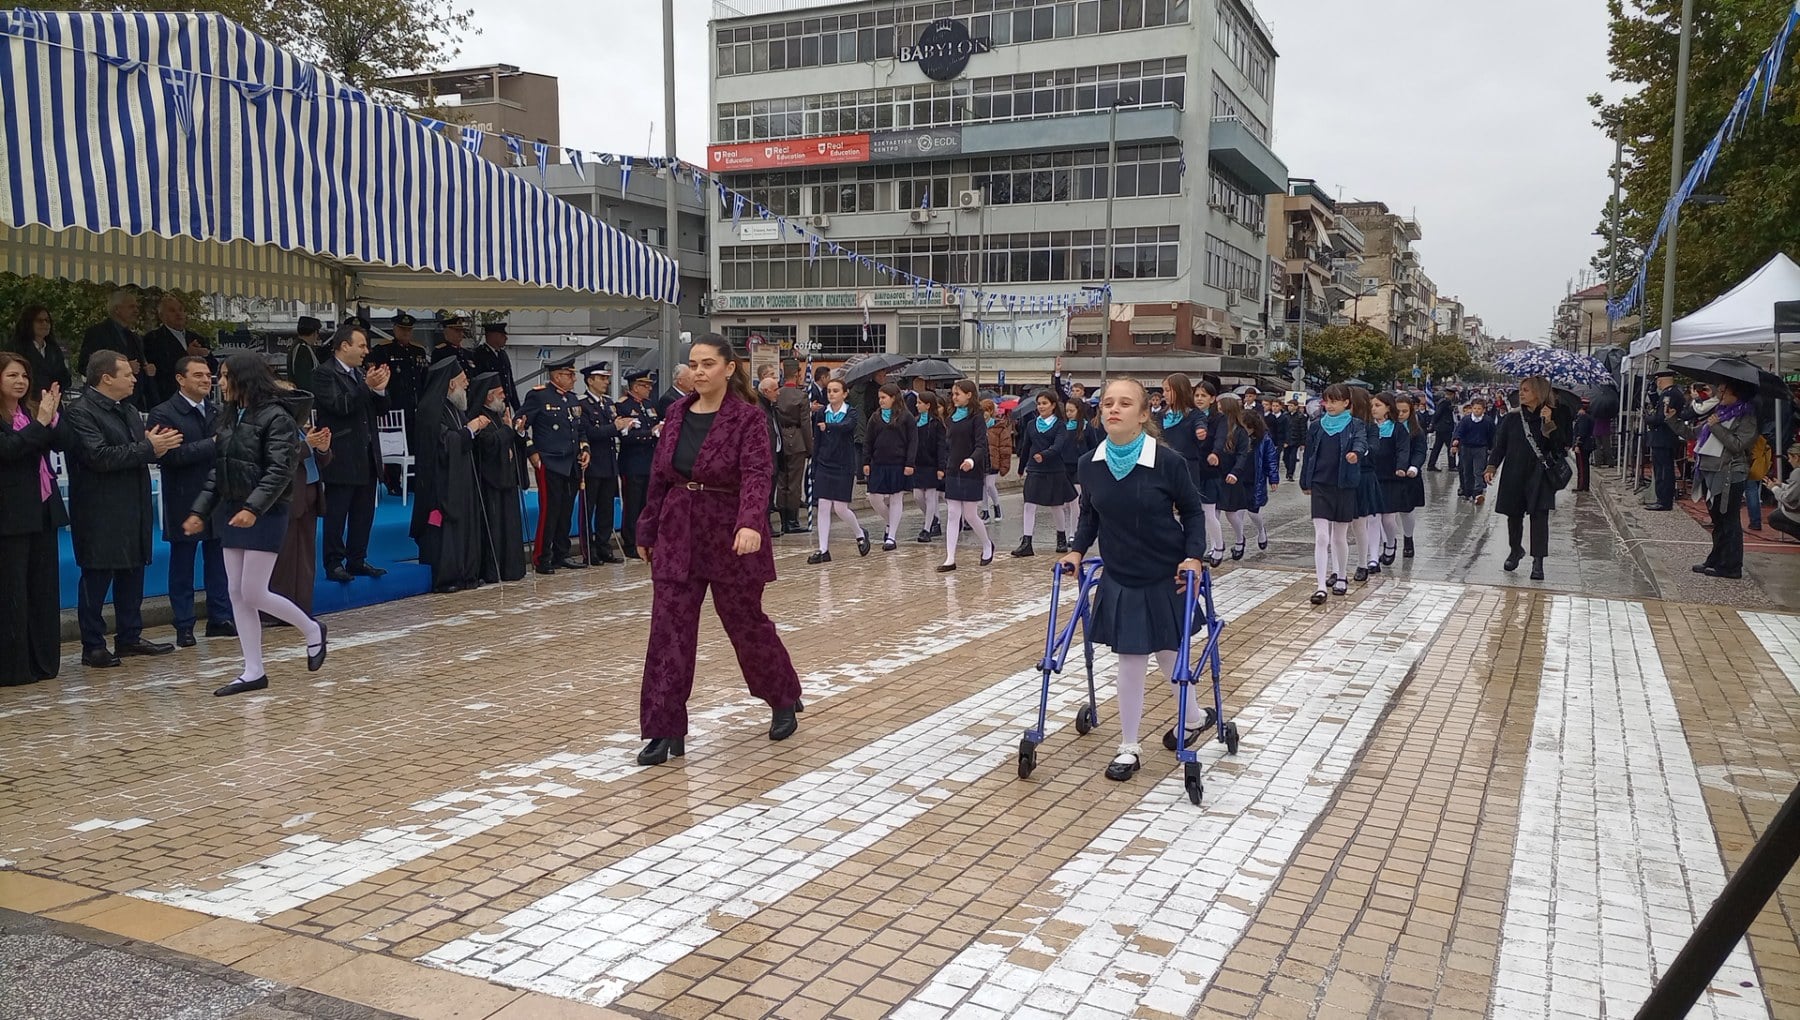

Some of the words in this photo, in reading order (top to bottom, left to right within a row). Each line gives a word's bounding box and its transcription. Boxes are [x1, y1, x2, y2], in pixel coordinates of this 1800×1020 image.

[900, 38, 988, 62] BABYLON
[826, 142, 844, 150] Real
[934, 137, 957, 147] ECDL
[722, 150, 738, 158] Real
[773, 146, 790, 154] Real
[794, 340, 822, 350] coffee
